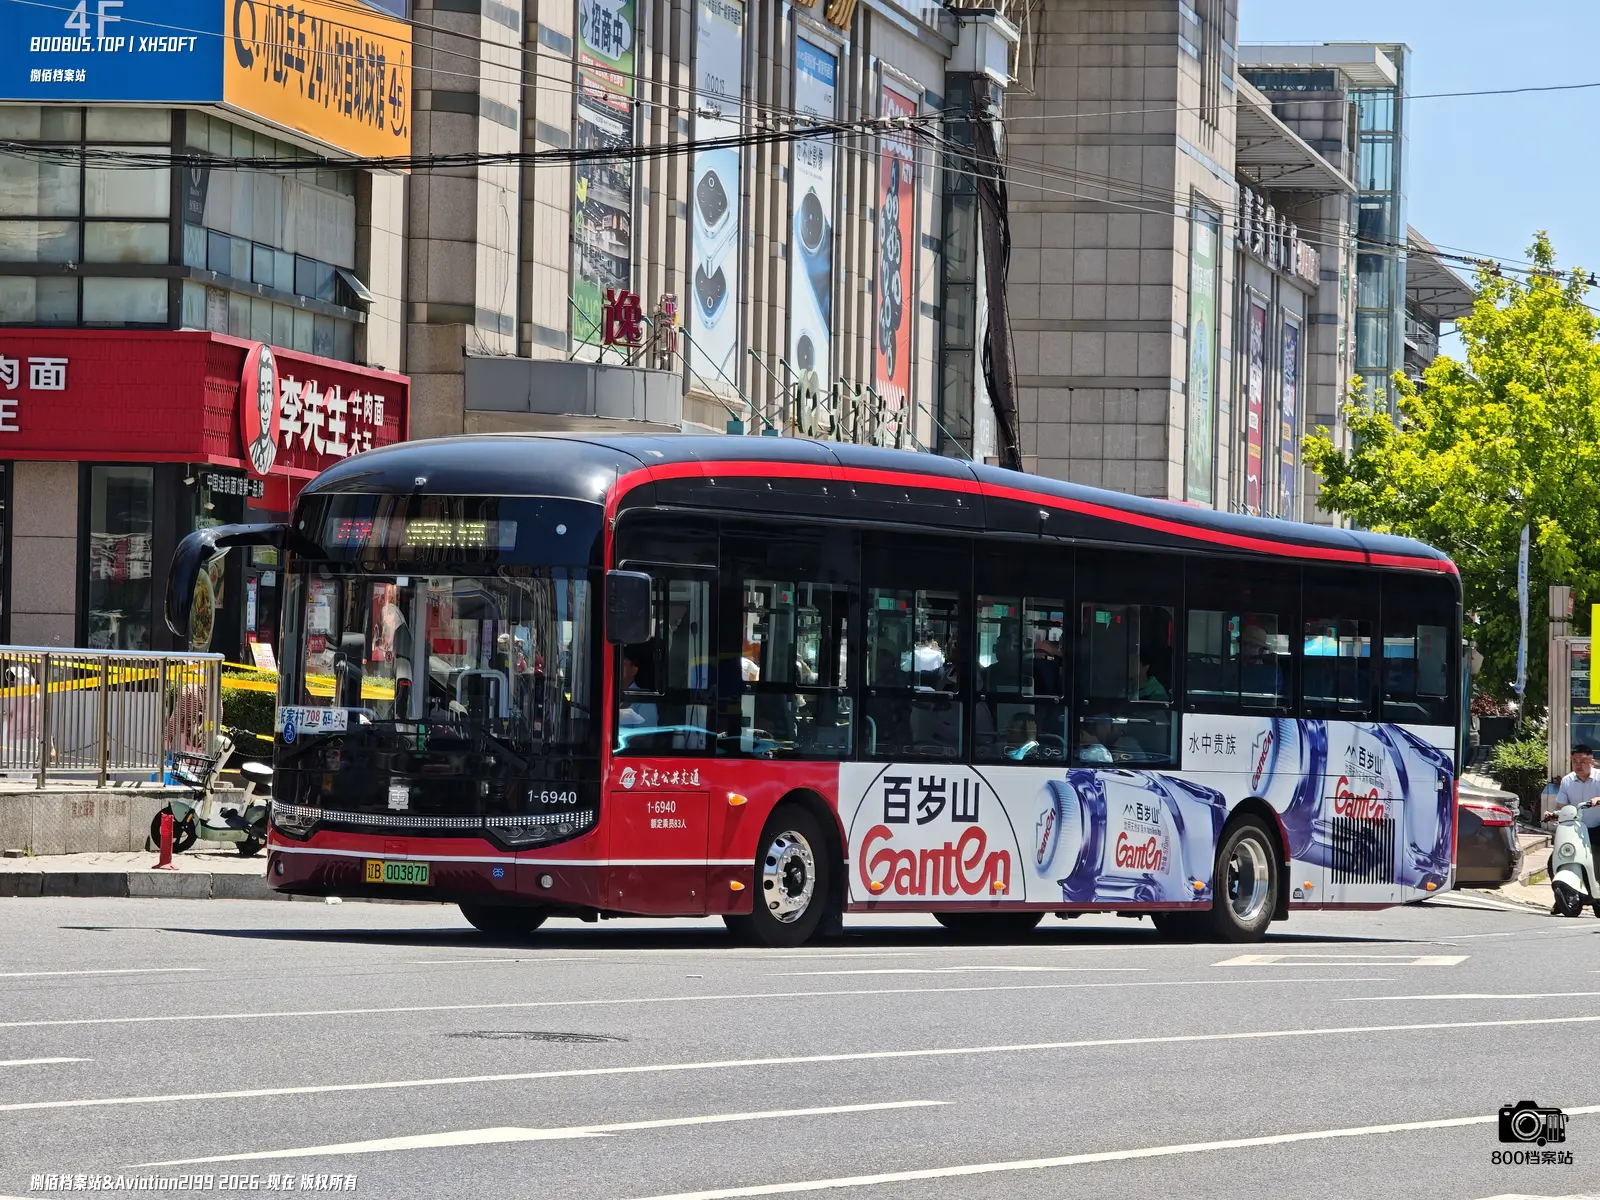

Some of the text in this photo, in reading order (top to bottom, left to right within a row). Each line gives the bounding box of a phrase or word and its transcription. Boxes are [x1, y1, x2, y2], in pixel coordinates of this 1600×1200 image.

[64, 0, 124, 37] 4F
[591, 0, 623, 57] 招商中
[278, 374, 348, 457] 李先生
[350, 389, 385, 426] 牛肉面
[306, 709, 320, 722] 708
[1189, 732, 1237, 755] 水中贵族
[1359, 746, 1382, 775] 百岁山
[528, 790, 577, 803] 1-6940
[647, 801, 676, 814] 1-6940
[883, 776, 980, 825] 百岁山
[650, 818, 686, 829] 额定乘员83人
[1136, 802, 1160, 824] 百岁山
